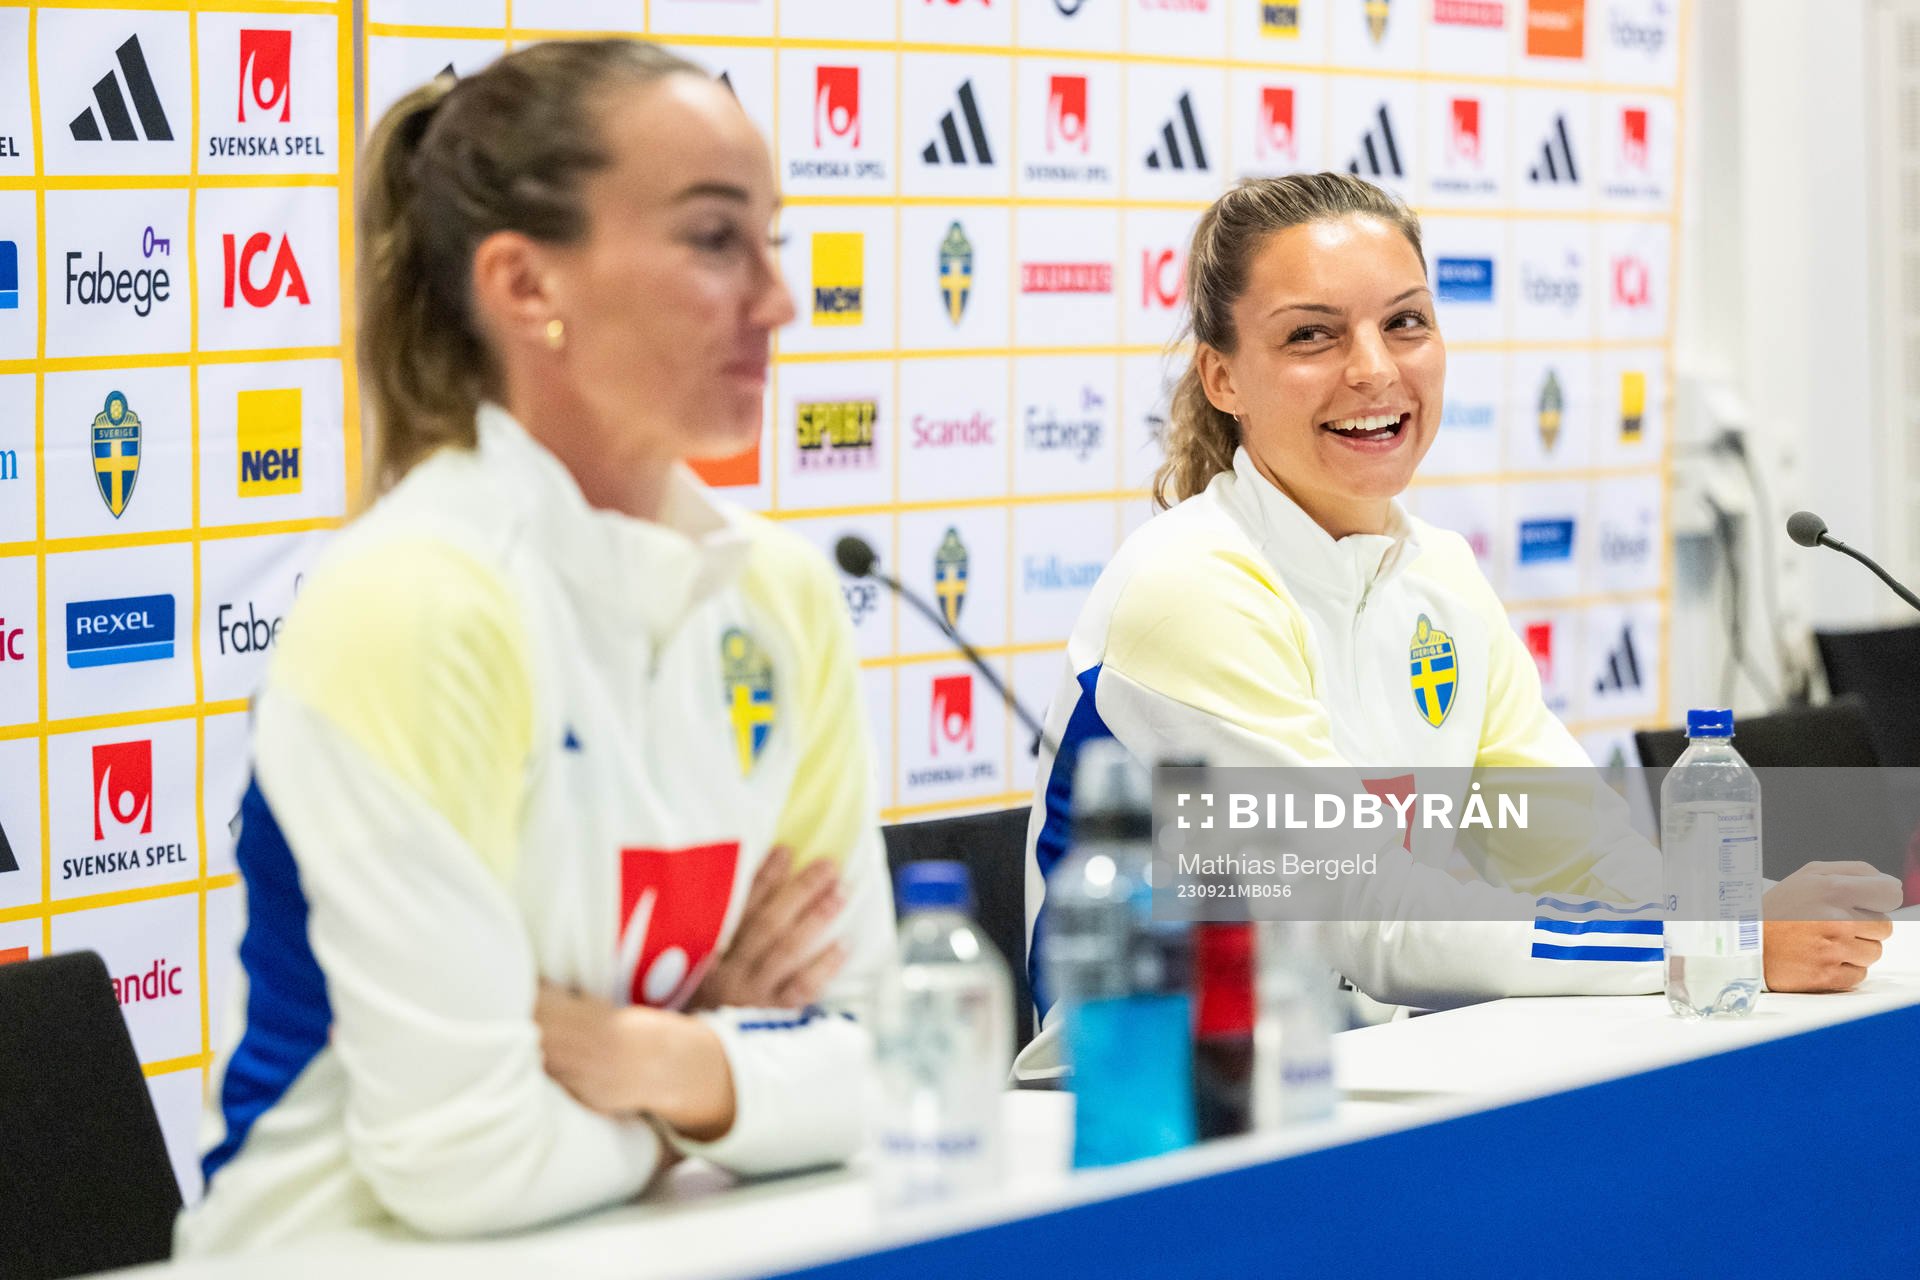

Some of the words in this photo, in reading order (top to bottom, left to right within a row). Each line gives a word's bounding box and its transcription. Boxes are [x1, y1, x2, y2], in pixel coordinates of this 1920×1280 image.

[0, 136, 20, 156] EL
[209, 136, 279, 156] SVENSKA
[285, 137, 324, 155] SPEL
[66, 251, 170, 317] Fabege
[222, 232, 311, 308] ICA
[1142, 249, 1187, 309] IC
[98, 428, 134, 439] SVERIGE
[218, 601, 284, 655] Fabe
[63, 849, 140, 879] SVENSKA
[146, 844, 187, 866] SPEL
[112, 958, 184, 1005] andic
